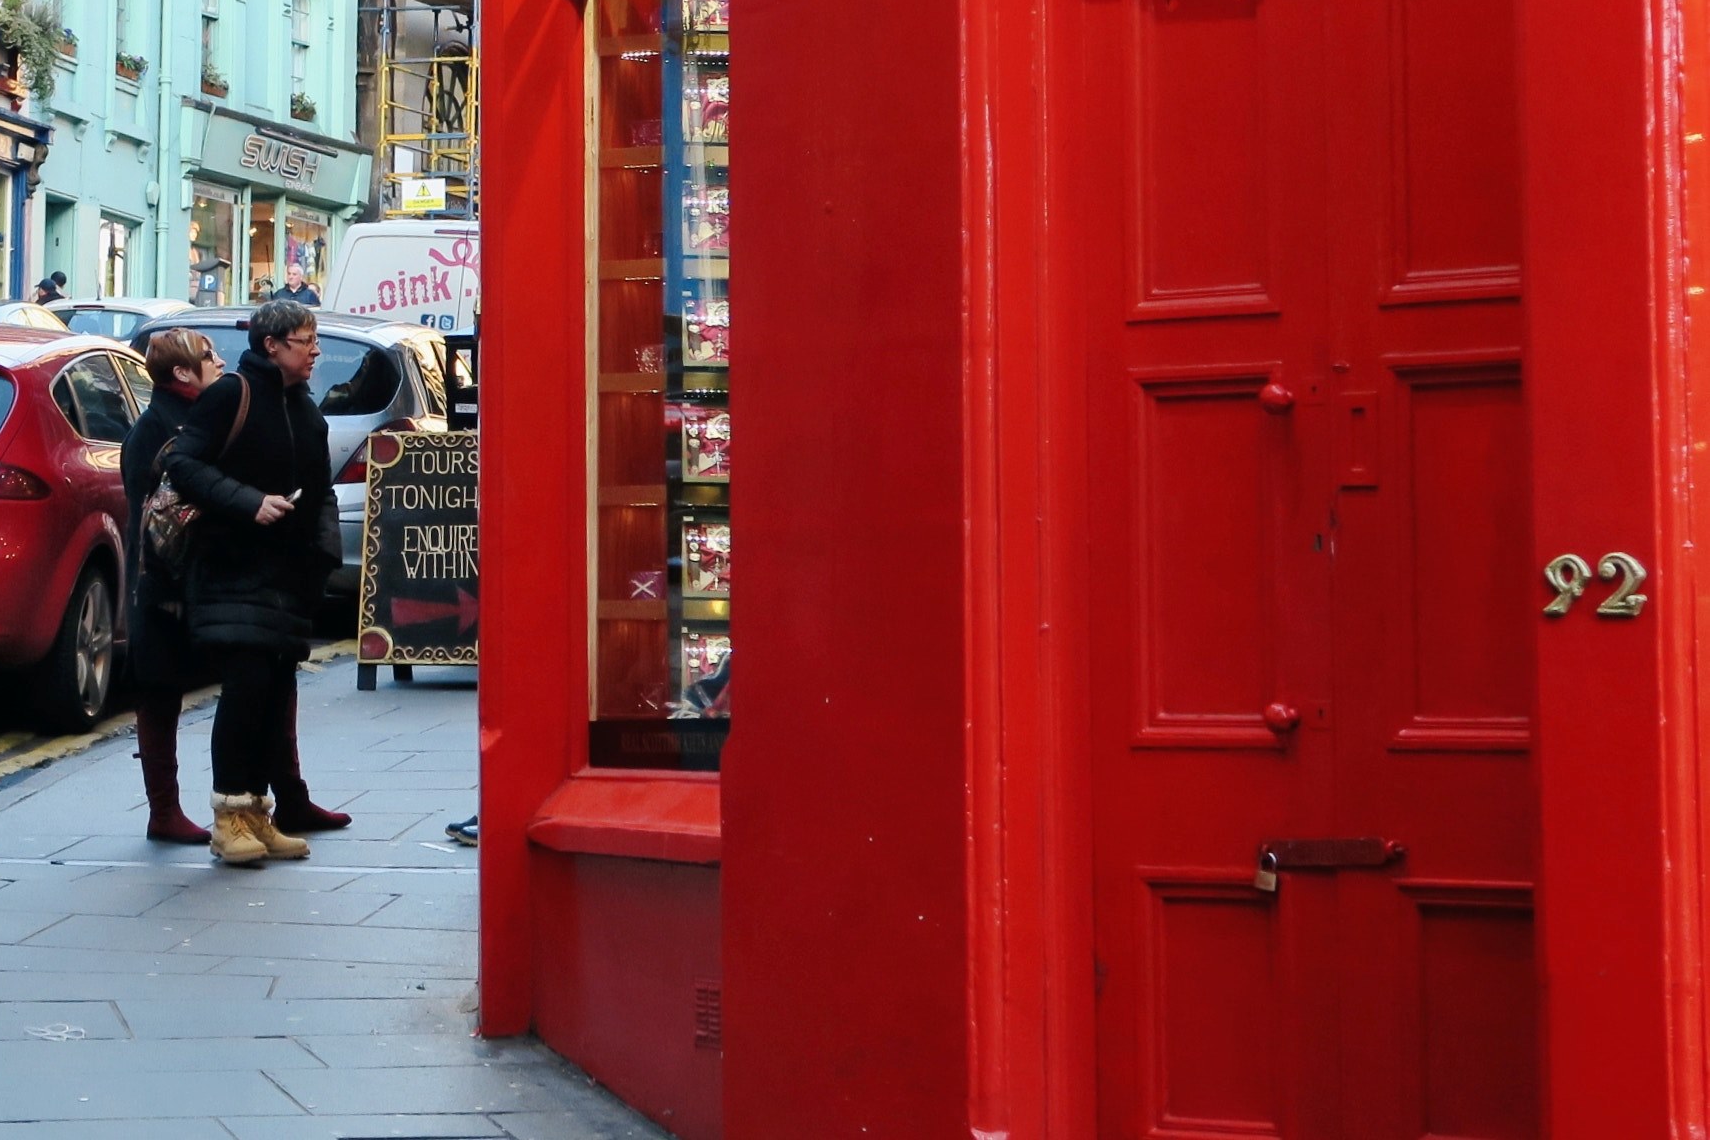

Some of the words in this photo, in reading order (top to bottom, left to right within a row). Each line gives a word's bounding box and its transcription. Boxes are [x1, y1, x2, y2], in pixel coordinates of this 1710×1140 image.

[241, 134, 322, 184] SWISH
[204, 274, 215, 289] P
[405, 451, 478, 474] TOURS
[385, 485, 478, 510] TONIGH
[403, 525, 478, 553] ENQUIRE
[401, 551, 478, 579] WITHIN
[1542, 551, 1648, 617] 92
